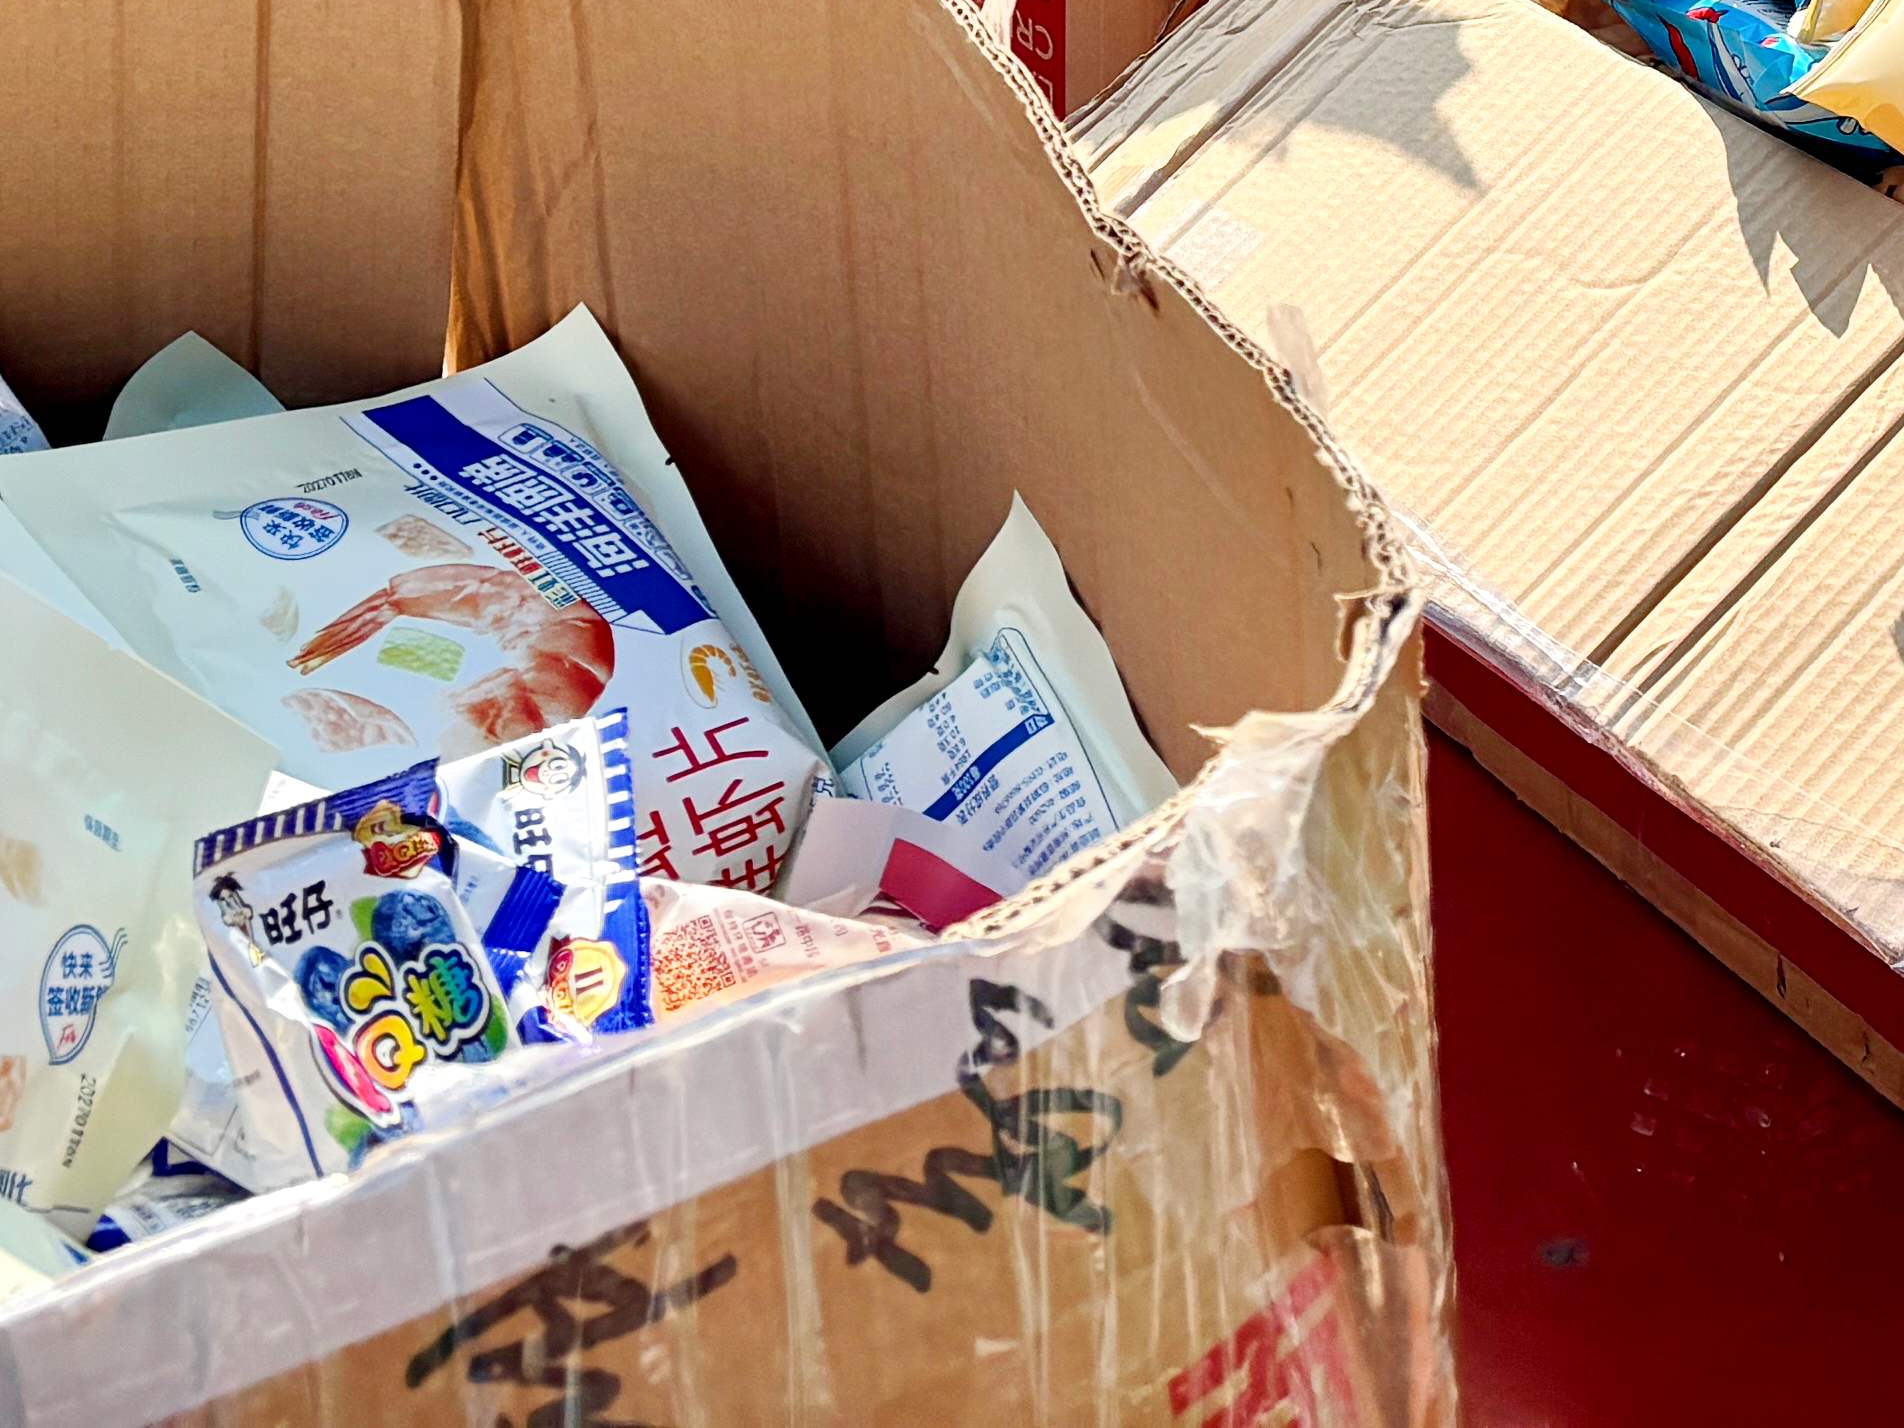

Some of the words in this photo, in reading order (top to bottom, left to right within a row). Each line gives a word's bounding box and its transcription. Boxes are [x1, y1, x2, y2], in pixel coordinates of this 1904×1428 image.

[457, 452, 651, 579] 海洋速递
[258, 879, 334, 946] 旺仔
[61, 951, 94, 981] 快来
